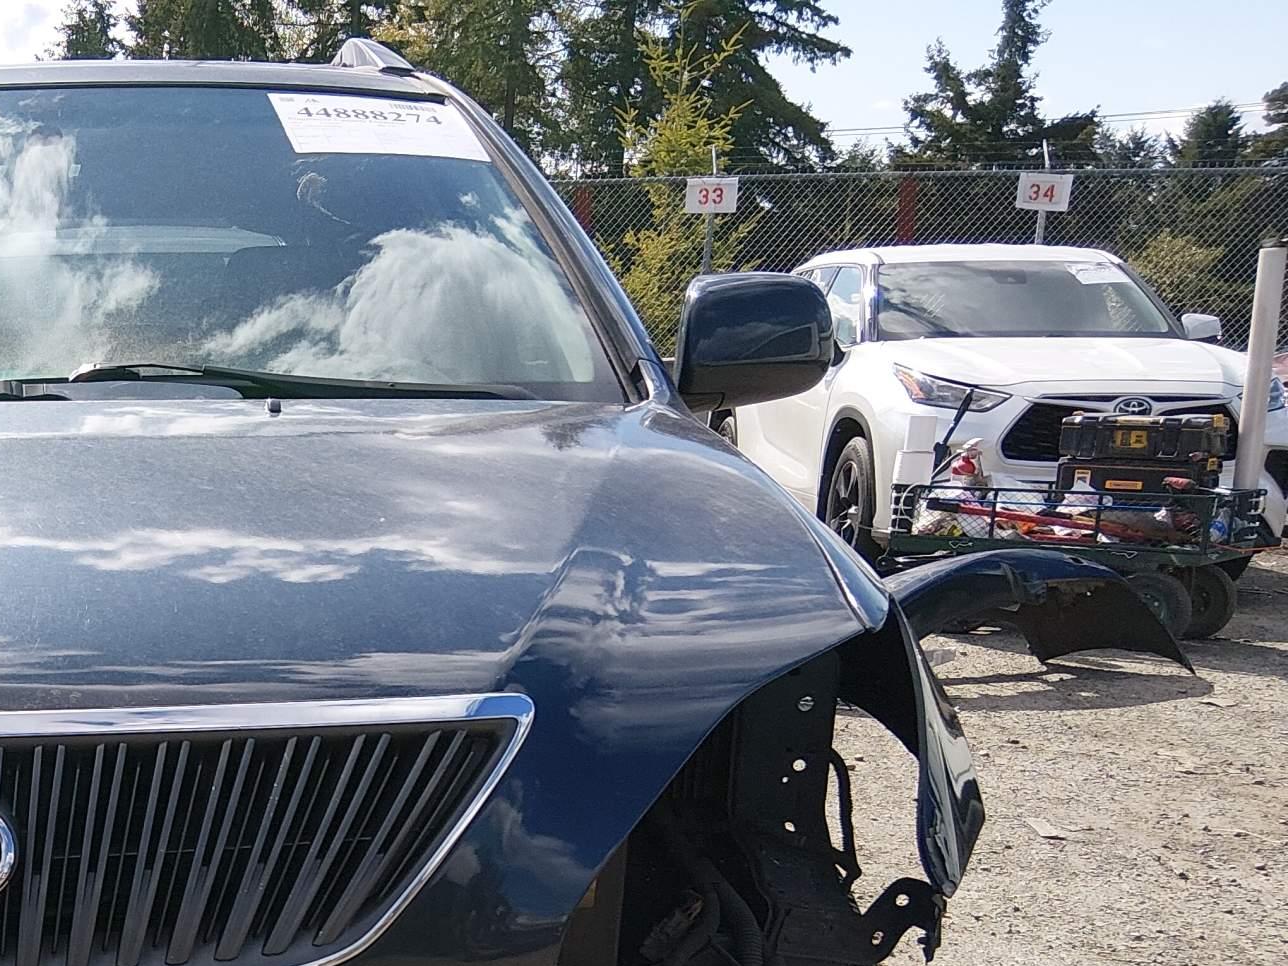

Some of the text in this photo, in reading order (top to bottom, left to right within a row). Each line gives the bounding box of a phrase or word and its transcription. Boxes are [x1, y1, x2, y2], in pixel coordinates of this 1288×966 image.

[297, 106, 442, 125] 44888274
[698, 187, 724, 205] 33
[1028, 183, 1055, 203] 34
